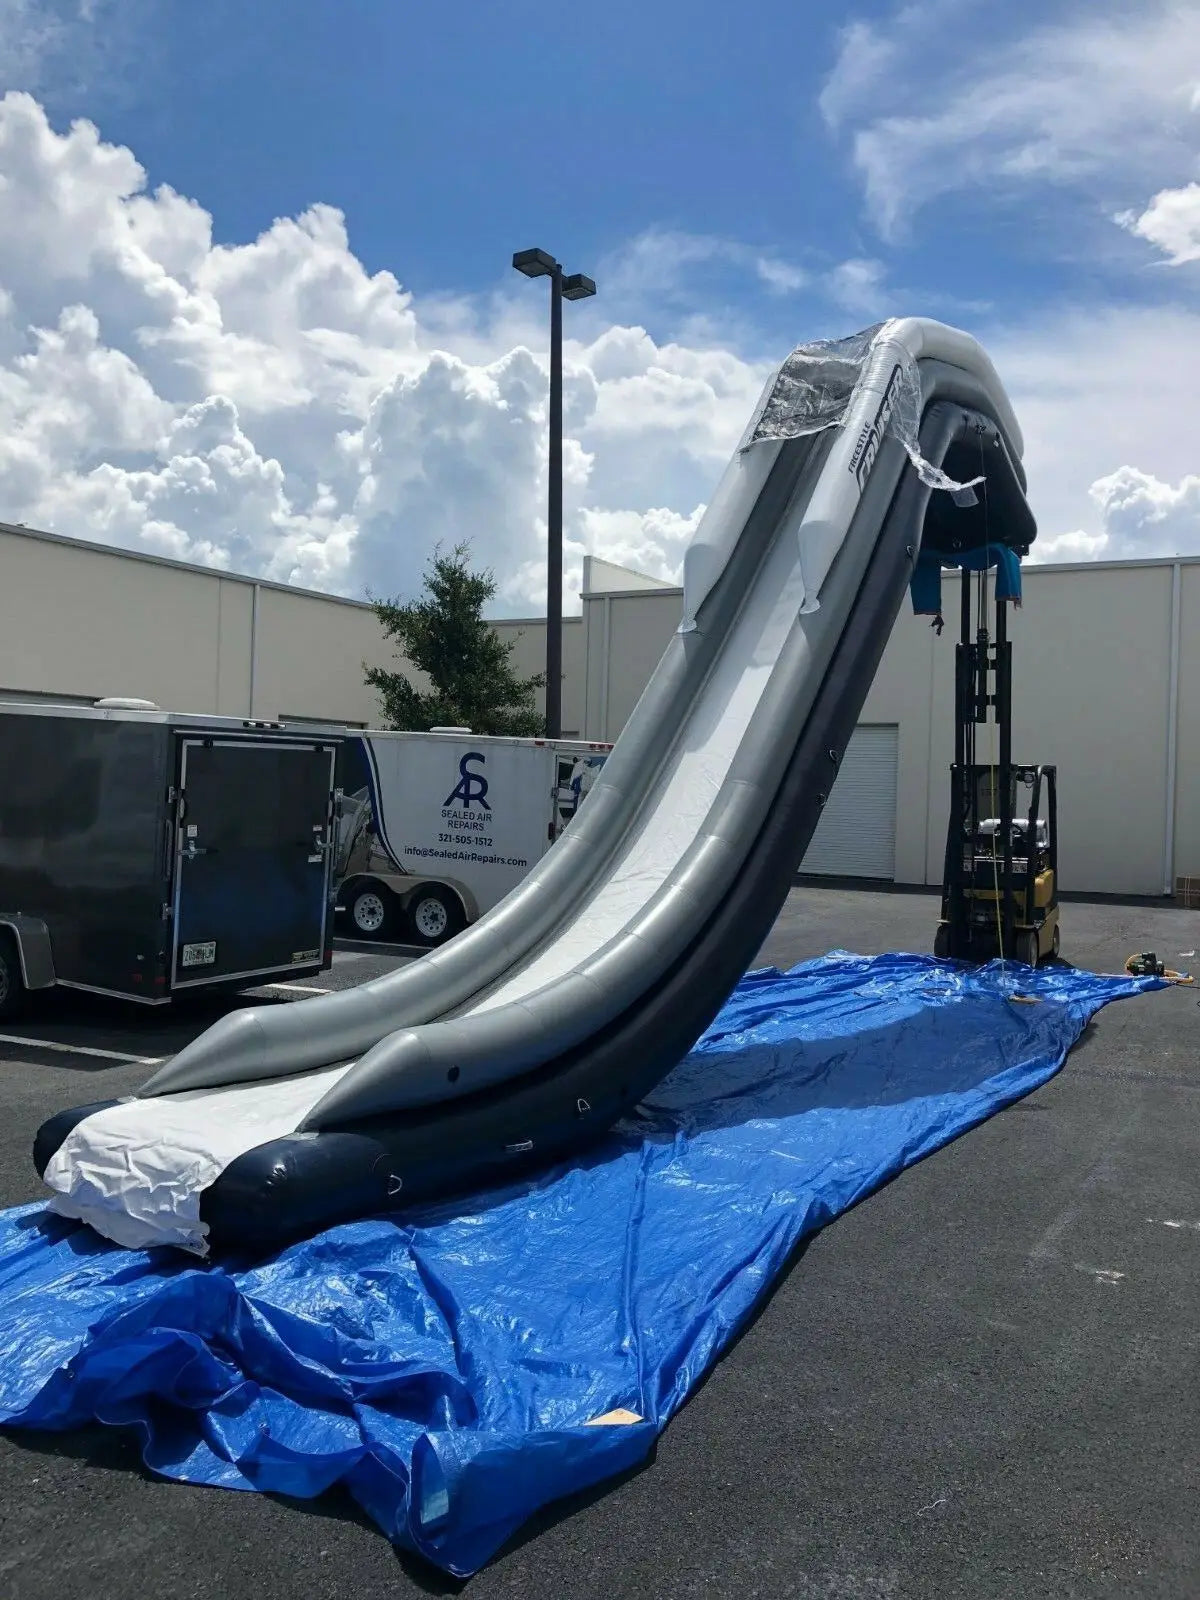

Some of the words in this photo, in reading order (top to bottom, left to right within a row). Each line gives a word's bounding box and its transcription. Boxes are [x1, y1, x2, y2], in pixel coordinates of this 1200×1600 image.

[848, 421, 871, 474] FREESTYLE
[441, 810, 475, 820] SEALED
[477, 812, 492, 822] AIR
[447, 820, 484, 831] REPAIRS
[438, 833, 493, 847] 321-505-1512
[404, 846, 527, 867] info@SealedAirRepairs.com
